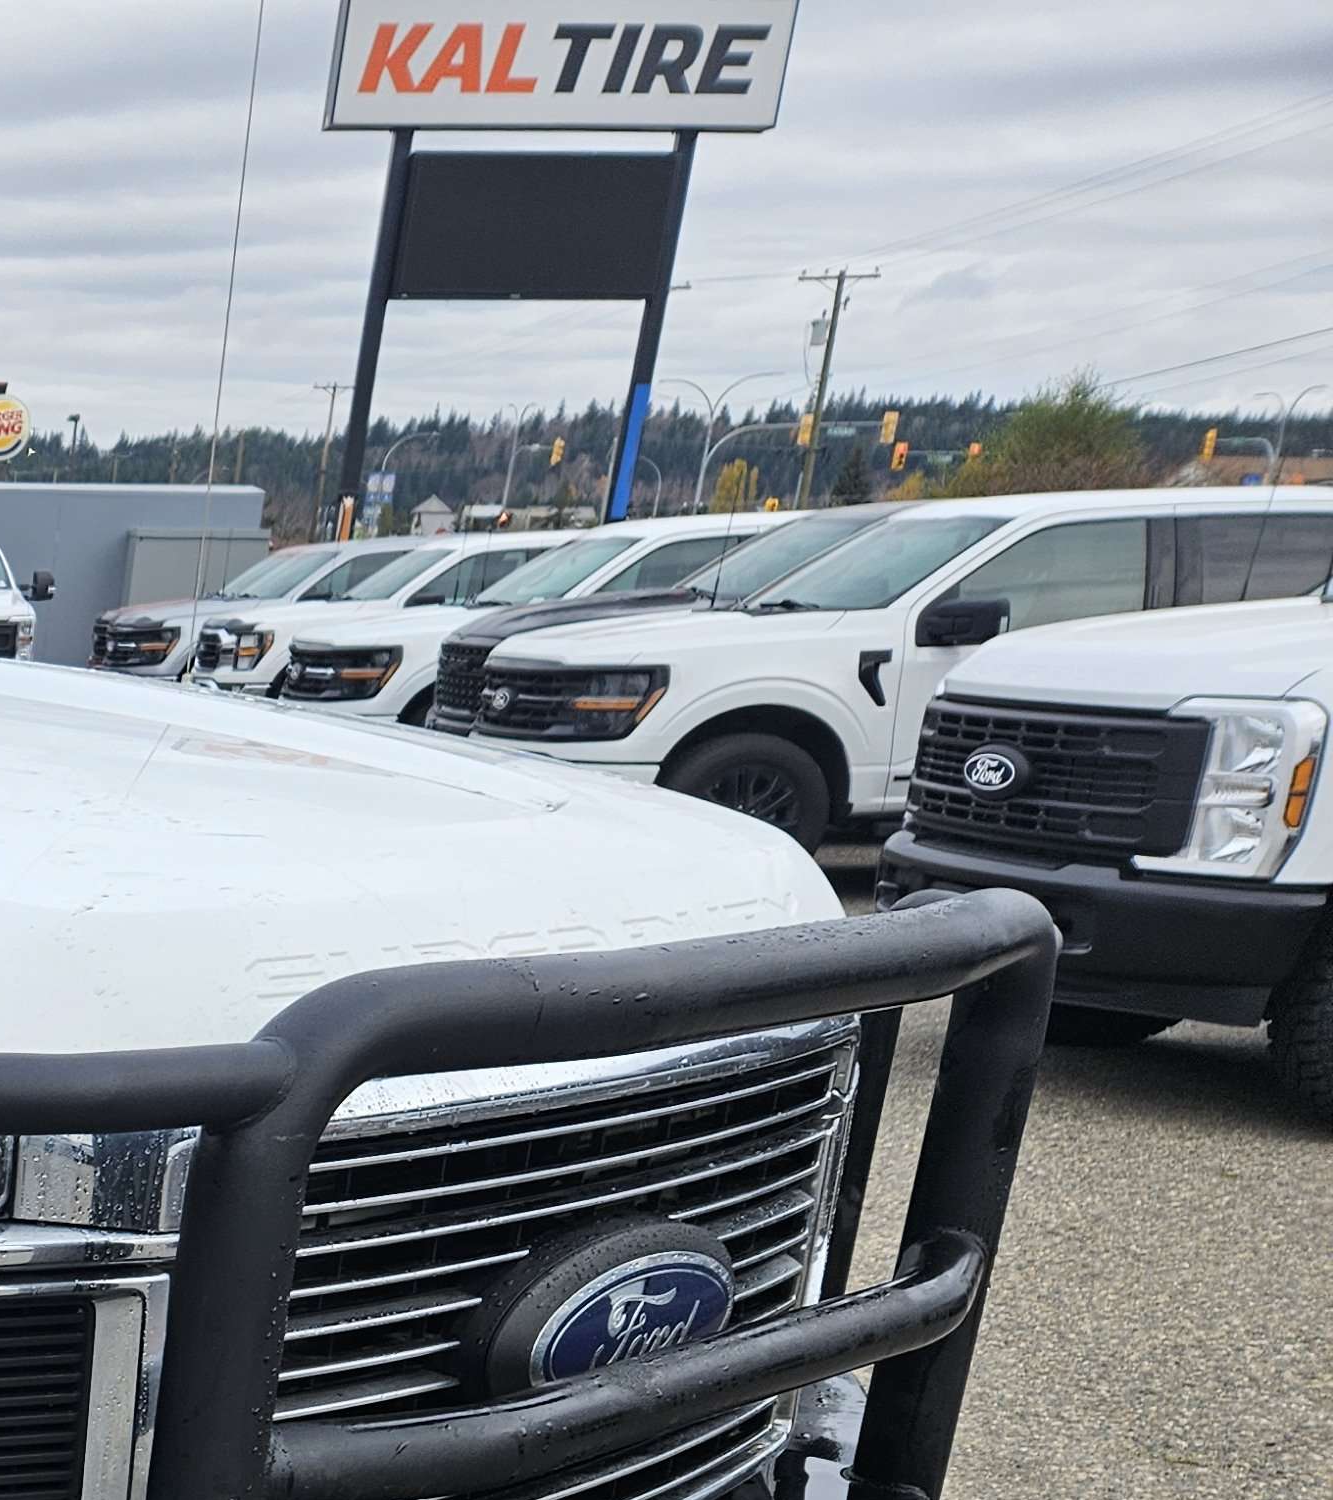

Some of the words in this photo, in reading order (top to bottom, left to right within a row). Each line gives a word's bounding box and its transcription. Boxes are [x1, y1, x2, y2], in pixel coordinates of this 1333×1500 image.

[357, 22, 537, 94] KAL
[552, 22, 772, 94] TIRE
[971, 757, 1007, 785] Ford
